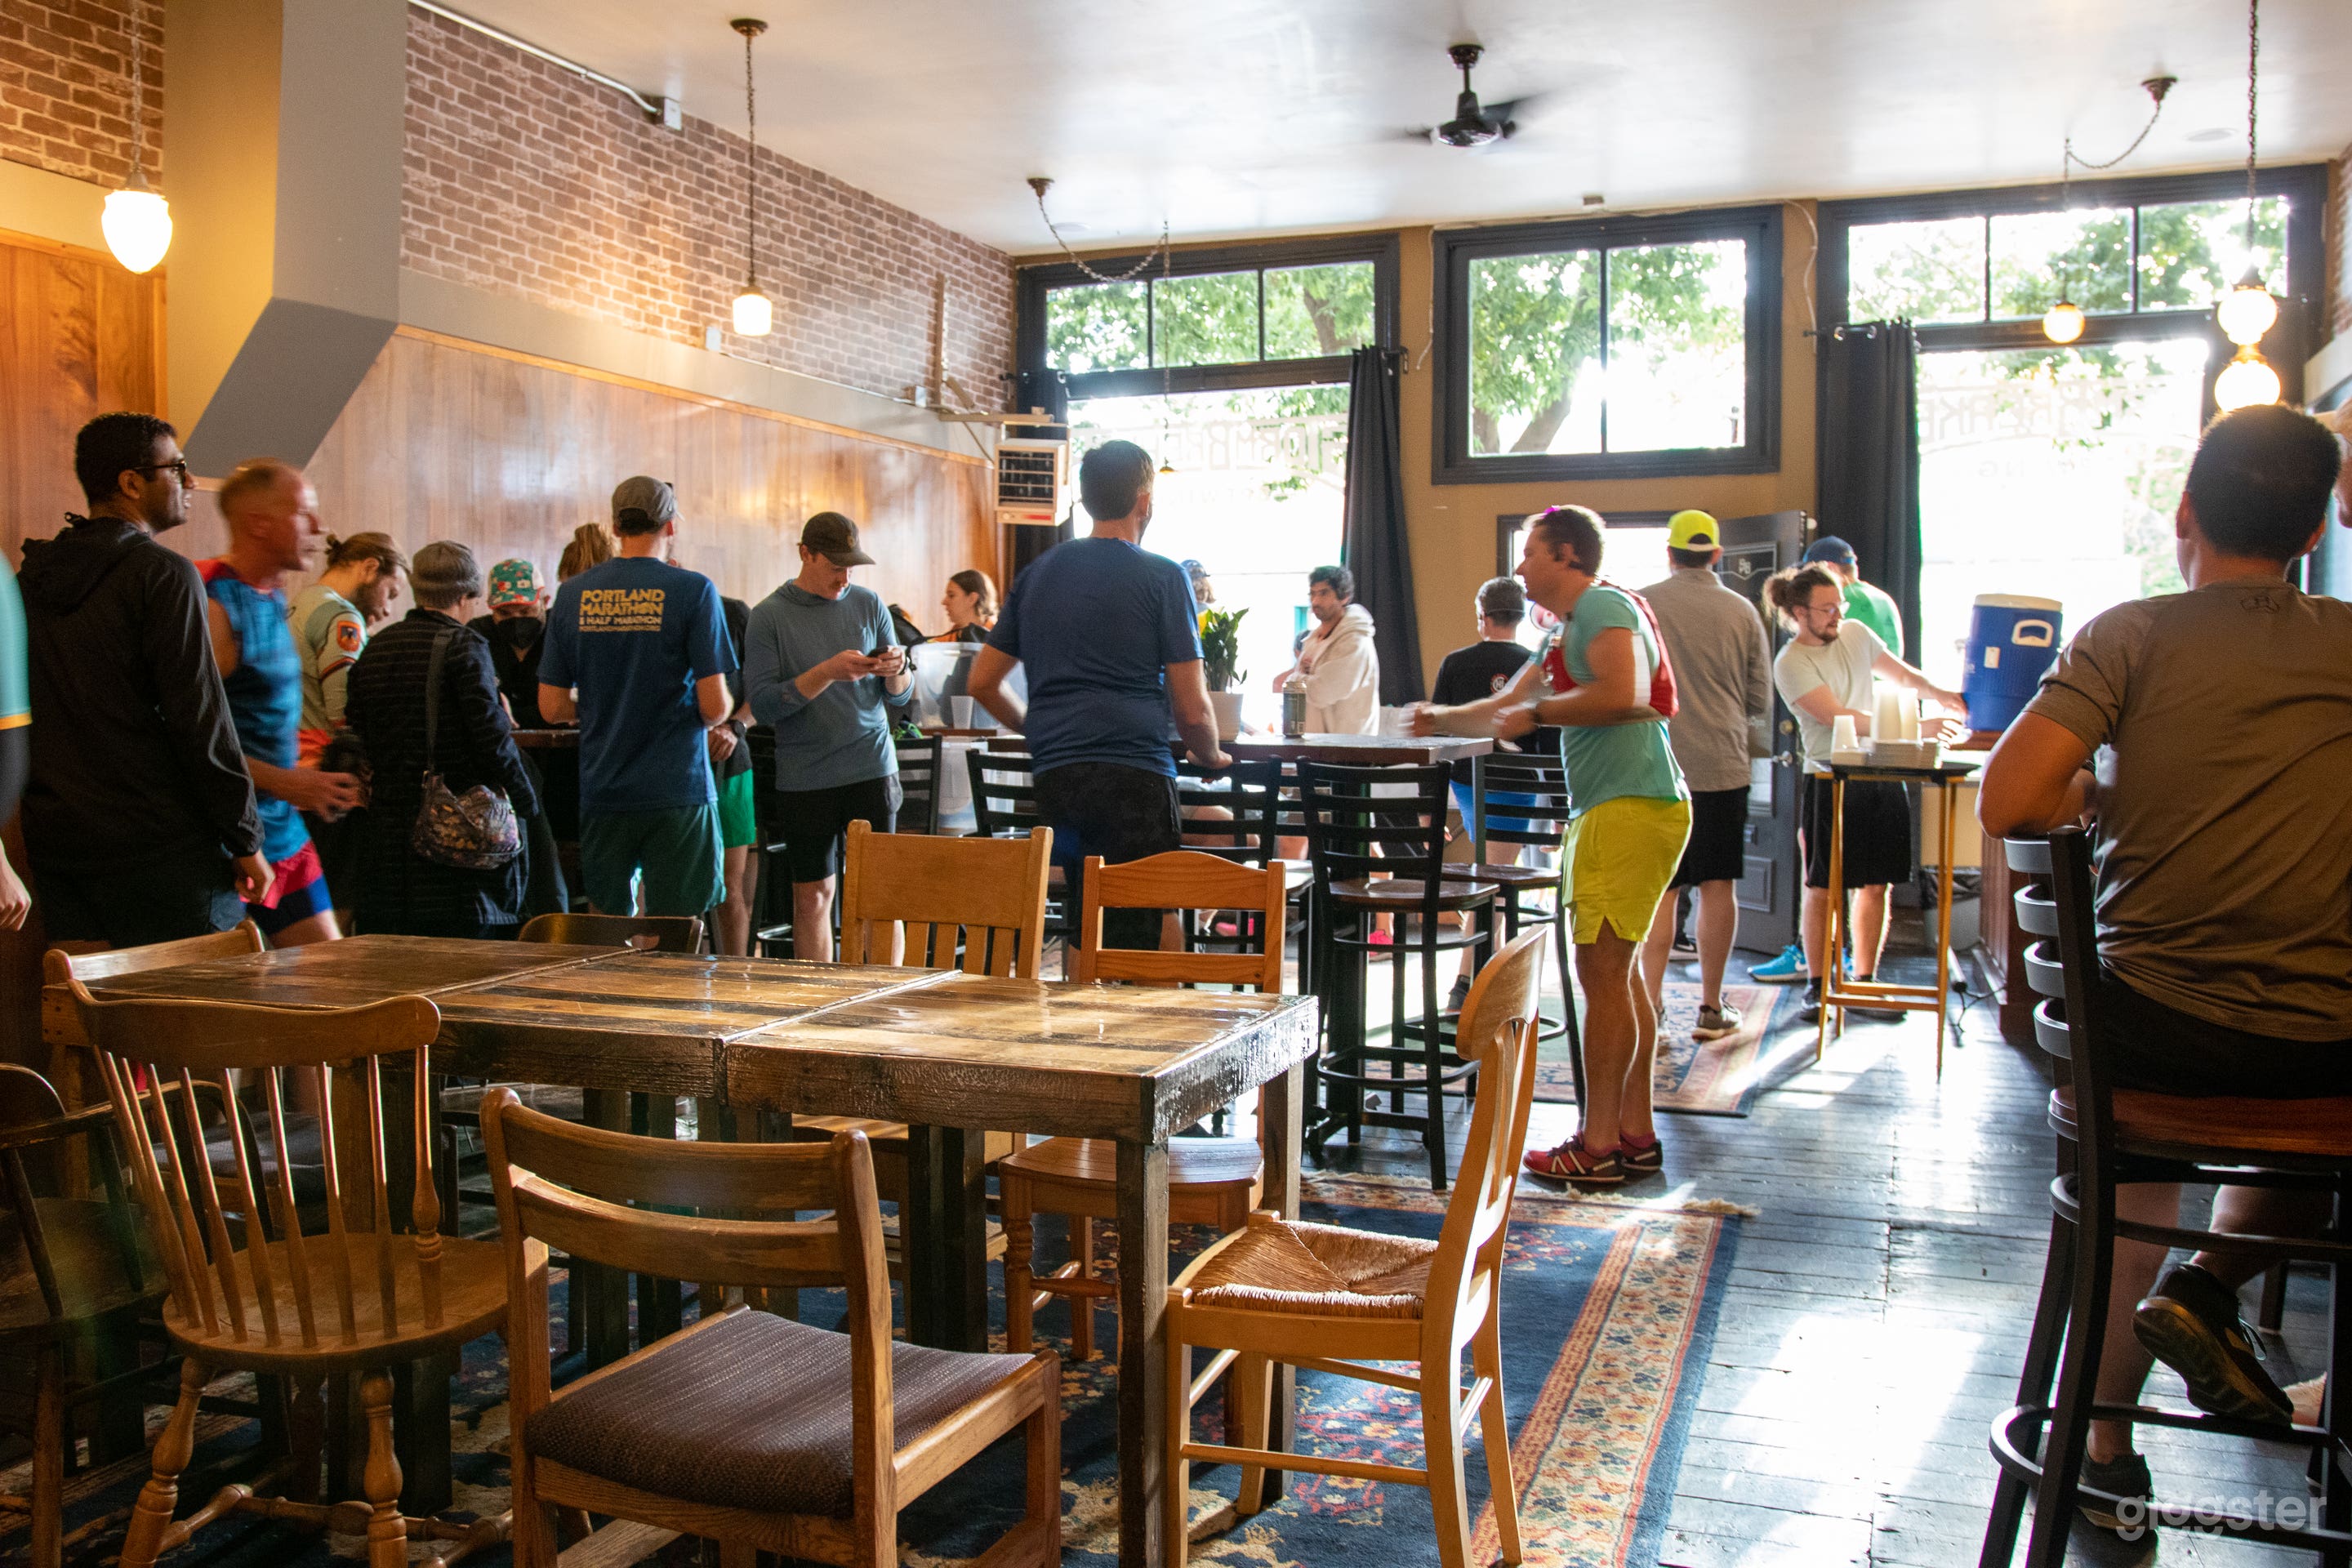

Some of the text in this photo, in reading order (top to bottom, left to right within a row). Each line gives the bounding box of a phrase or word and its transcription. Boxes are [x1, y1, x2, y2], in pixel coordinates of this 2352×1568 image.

[581, 589, 666, 602] PORTLAND
[579, 602, 664, 616] MARATHON
[586, 617, 612, 625] HALF
